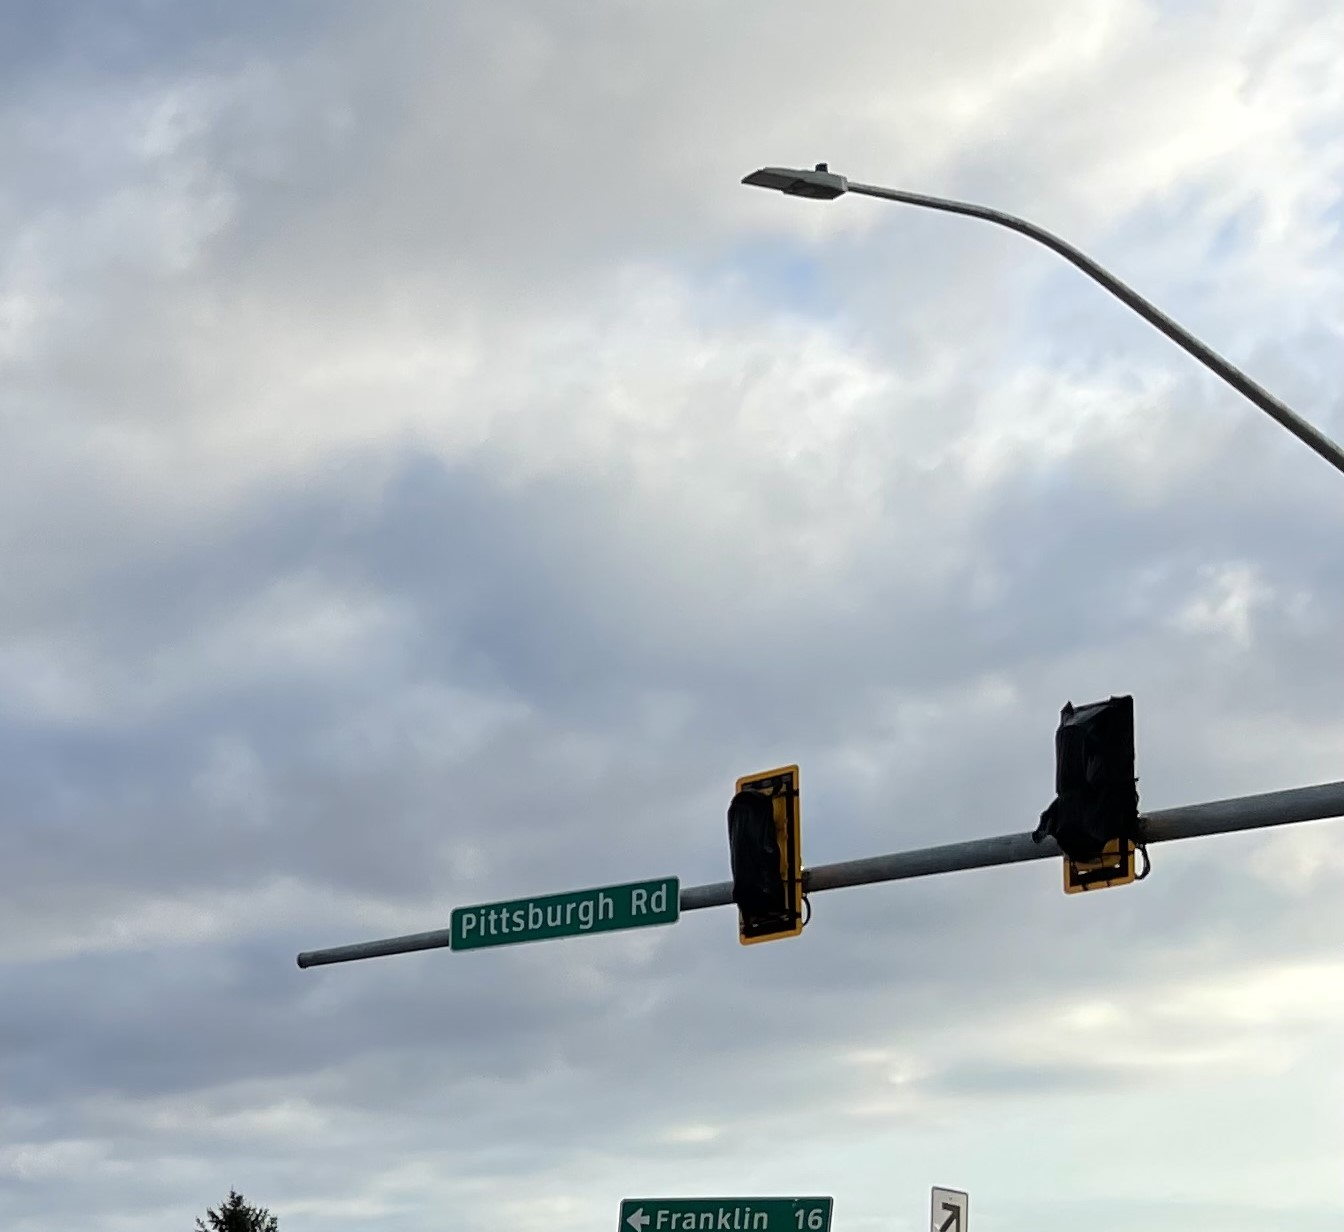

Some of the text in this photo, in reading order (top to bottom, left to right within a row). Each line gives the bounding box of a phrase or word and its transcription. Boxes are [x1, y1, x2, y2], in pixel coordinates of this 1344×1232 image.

[462, 883, 667, 939] Pittsburgh Rd
[656, 1207, 823, 1230] Franklin 16
